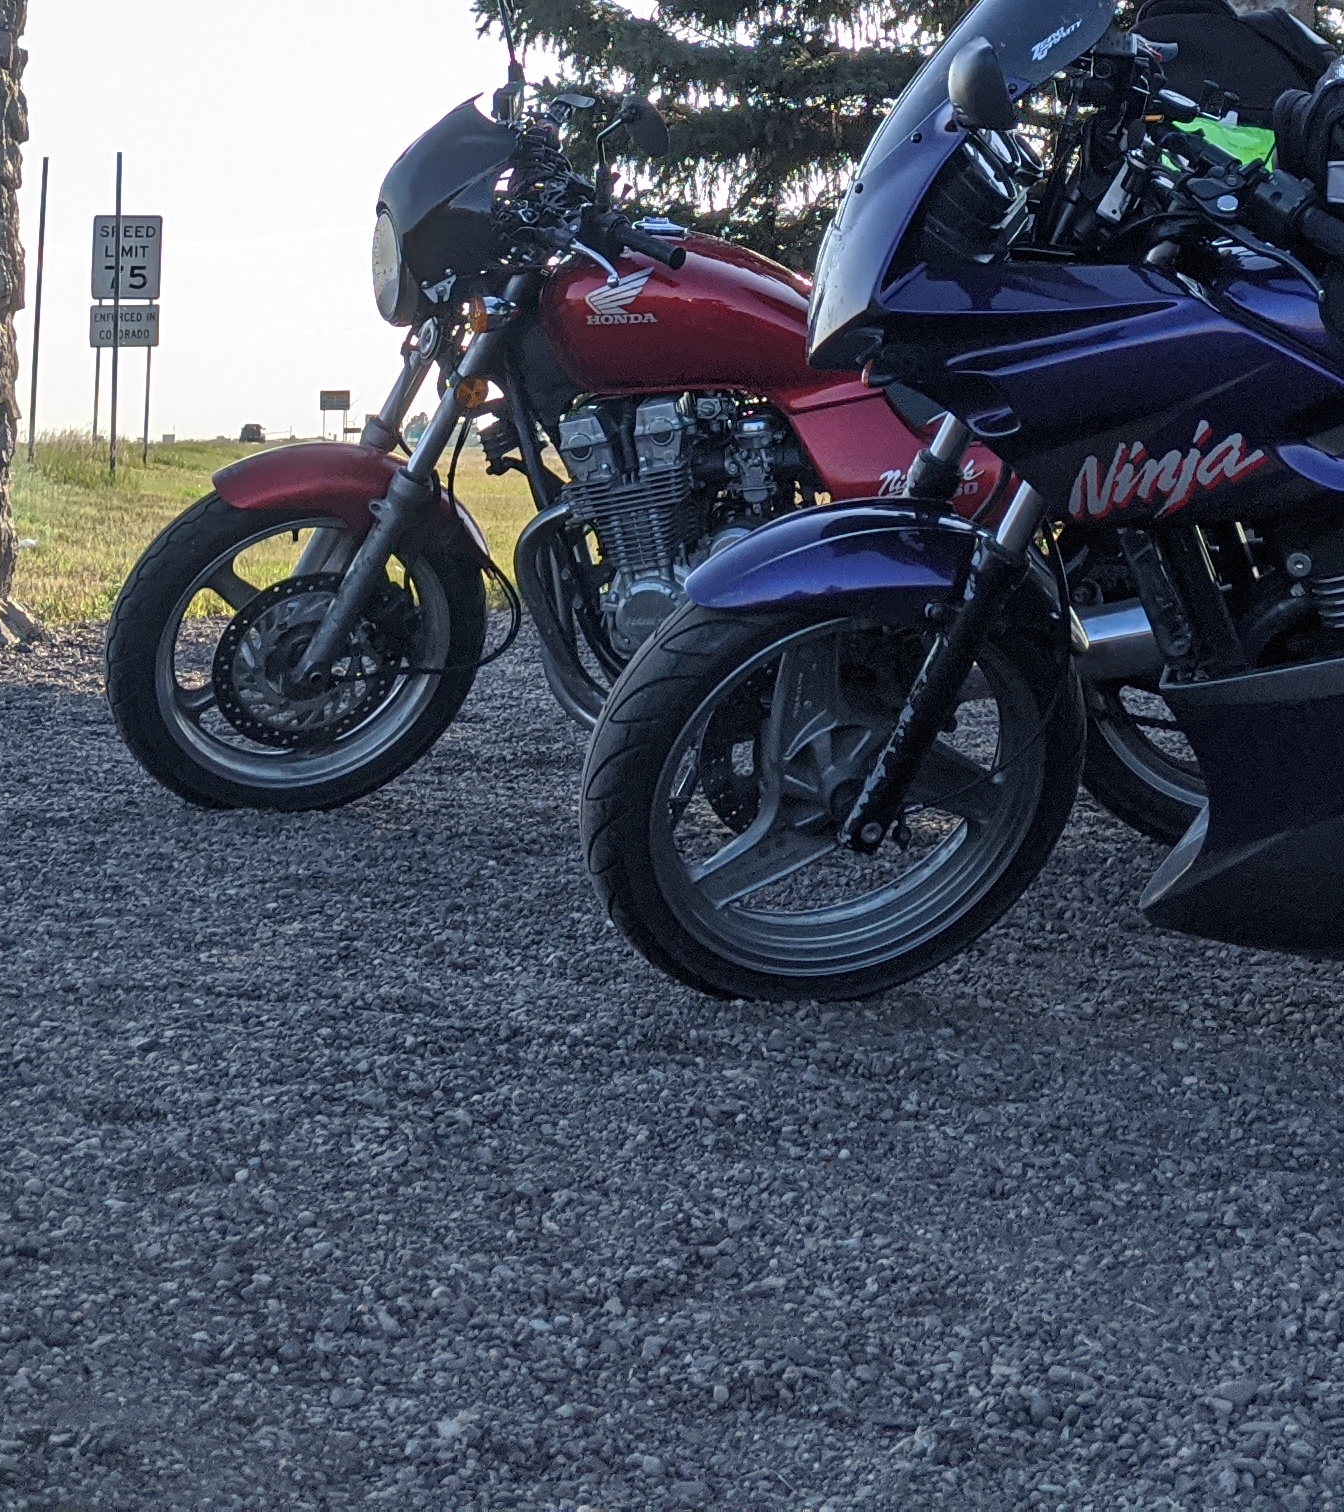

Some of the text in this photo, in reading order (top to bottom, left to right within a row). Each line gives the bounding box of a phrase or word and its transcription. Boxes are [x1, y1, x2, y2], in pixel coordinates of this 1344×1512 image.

[104, 244, 150, 259] LMIT
[104, 265, 148, 290] 75
[146, 311, 156, 322] IN
[586, 312, 658, 326] HONDA
[99, 329, 150, 340] COORADO
[1068, 419, 1269, 521] Ninja
